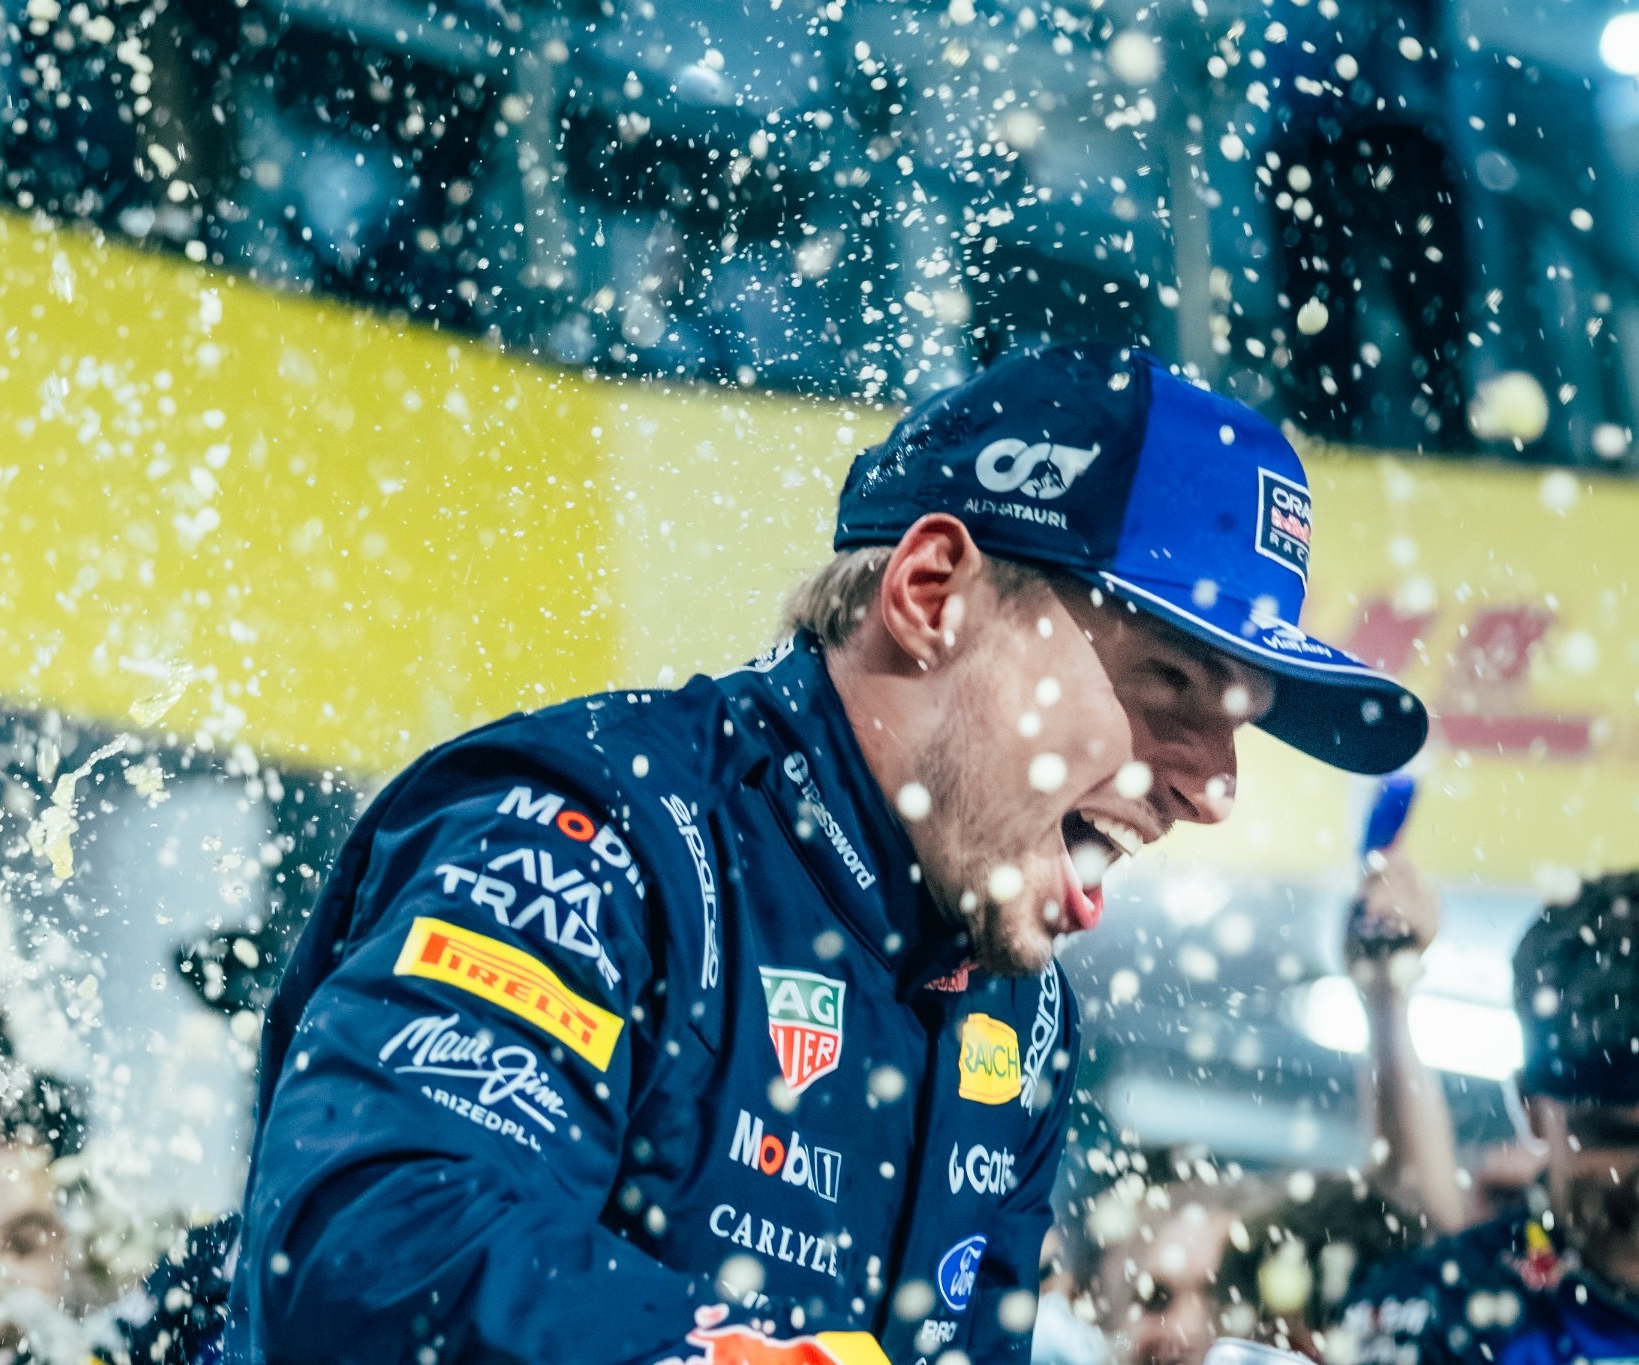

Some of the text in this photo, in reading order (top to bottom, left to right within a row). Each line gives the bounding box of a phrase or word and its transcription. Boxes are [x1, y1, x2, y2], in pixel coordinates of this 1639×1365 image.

[487, 848, 602, 933] AVA
[419, 931, 599, 1047] PIRELLI
[1020, 958, 1061, 1118] sparc
[709, 1203, 839, 1279] CARLYLE
